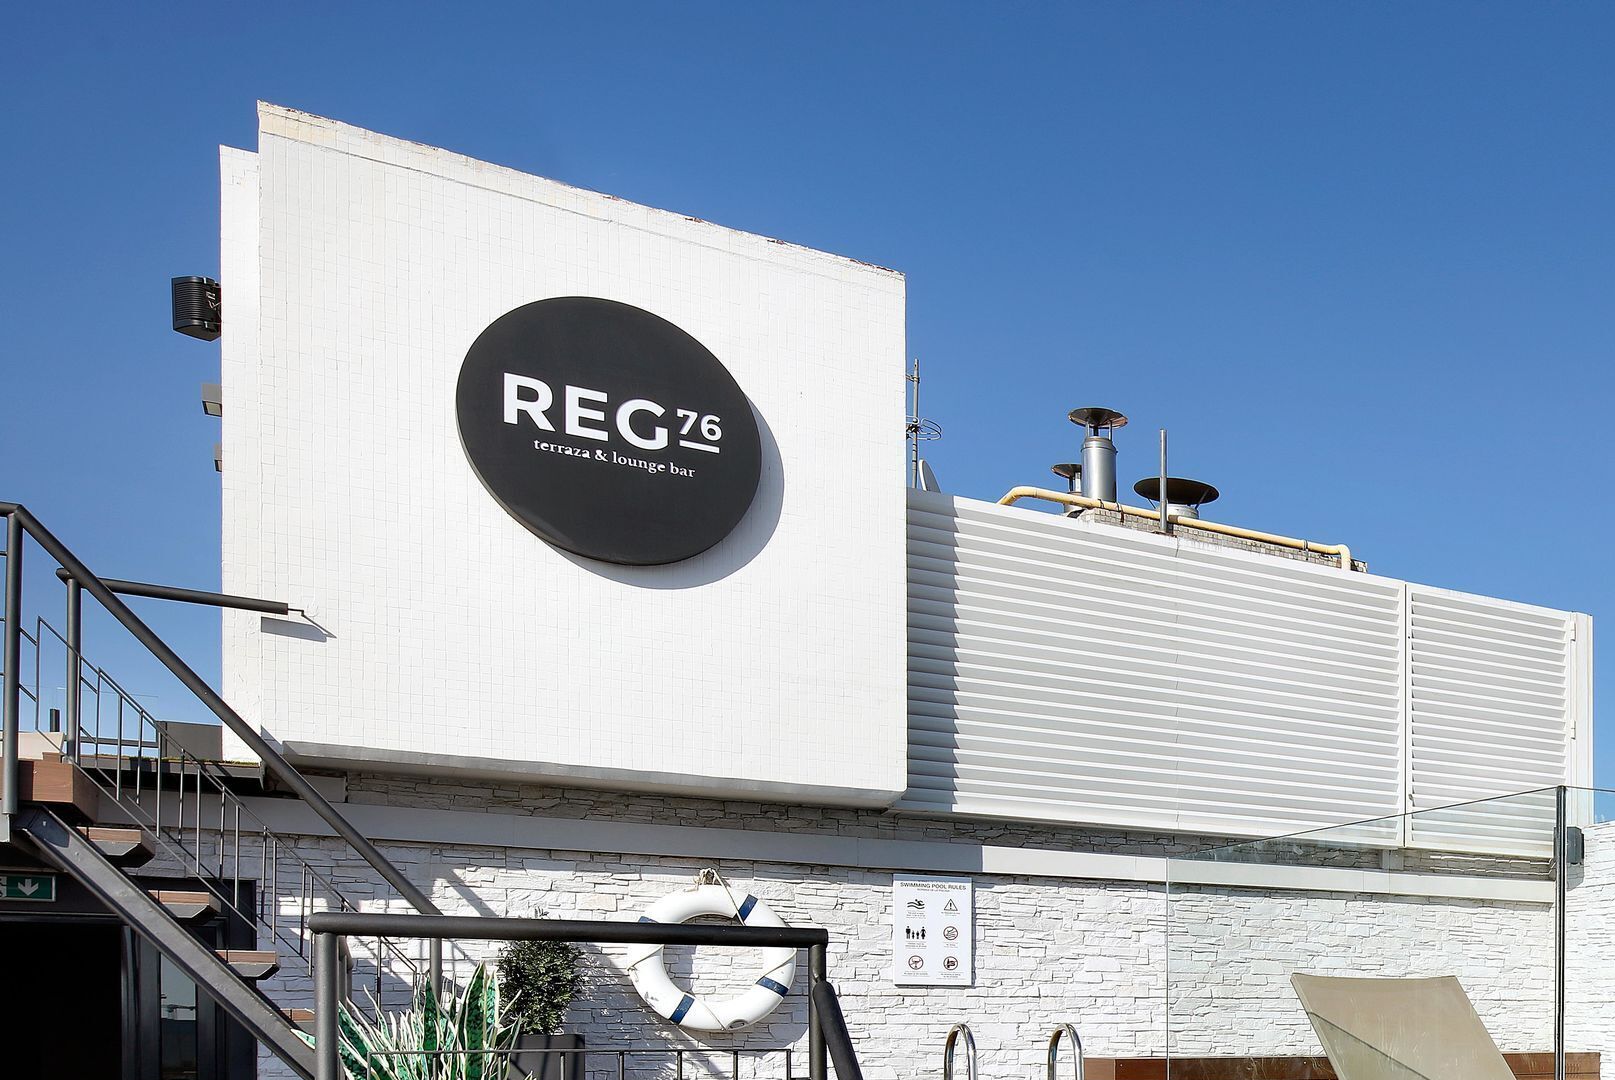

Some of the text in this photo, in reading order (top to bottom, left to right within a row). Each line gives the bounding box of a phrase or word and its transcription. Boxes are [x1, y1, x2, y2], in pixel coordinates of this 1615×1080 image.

[503, 372, 723, 451] REG 76
[534, 439, 696, 479] terraza & lounge bar
